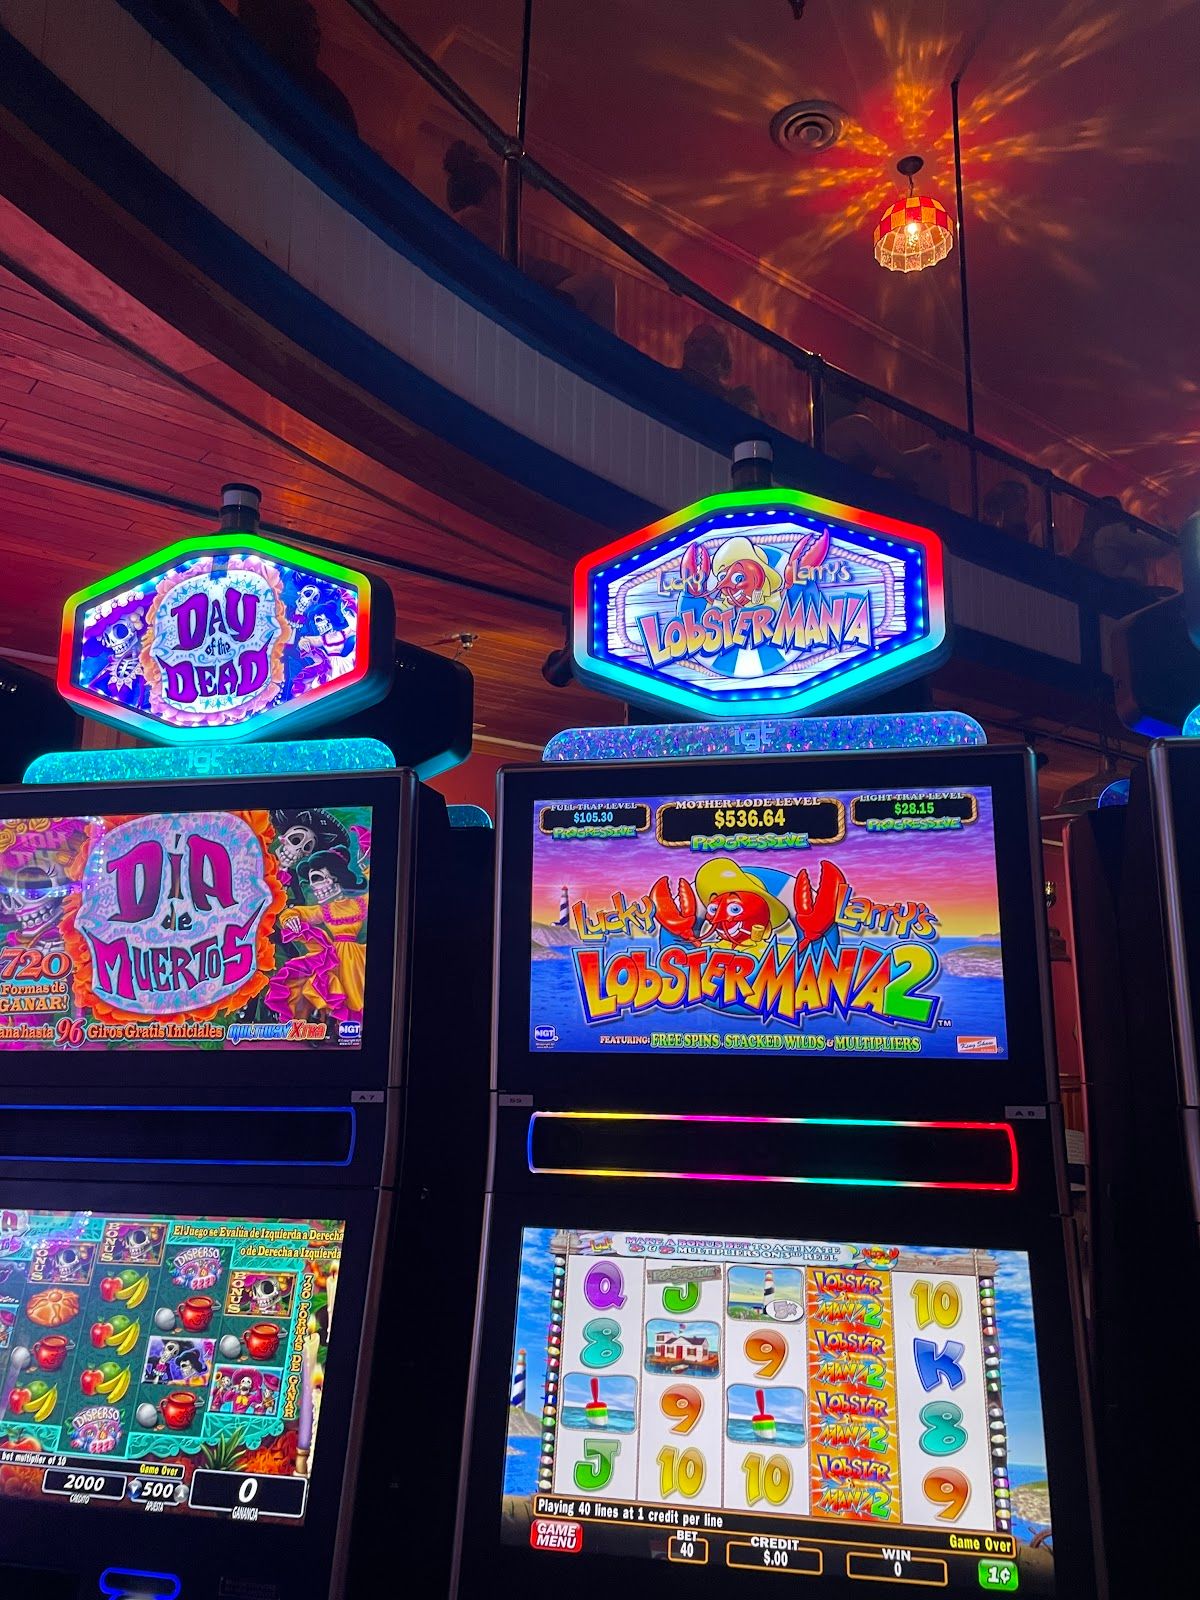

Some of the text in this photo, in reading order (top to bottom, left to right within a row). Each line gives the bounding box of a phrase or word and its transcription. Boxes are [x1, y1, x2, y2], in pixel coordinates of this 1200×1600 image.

[791, 558, 854, 586] Larry's
[656, 569, 706, 598] Lucky
[172, 587, 261, 651] DAY
[205, 637, 231, 656] of the
[163, 644, 271, 703] DEAD
[577, 803, 604, 811] TRAP
[605, 802, 638, 810] LEVEL
[675, 797, 821, 810] MOTHER LODE LEVEL
[860, 792, 965, 802] LIGHT TRAP LEVEL
[573, 811, 614, 823] $105.30
[894, 802, 935, 815] $28.15
[714, 808, 786, 830] $536.64
[866, 817, 962, 831] PROGRESSIVE
[552, 826, 637, 840] PROGRESSIVE
[690, 833, 810, 851] PROGRESSIVE
[160, 901, 193, 932] de
[572, 891, 656, 942] Lucky
[834, 882, 939, 940] Larry's
[1, 948, 72, 979] 720
[82, 912, 261, 1000] MUERTOS
[2, 981, 66, 995] Formas de
[20, 1024, 54, 1039] hasta
[57, 1018, 87, 1044] 96
[87, 1024, 123, 1039] Giros
[124, 1024, 165, 1039] Gratis
[166, 1024, 224, 1038] Iniciales
[599, 1035, 650, 1045] FEATURING:
[650, 1032, 684, 1047] FREE
[725, 1034, 782, 1049] STACKED
[782, 1035, 825, 1050] WILDS
[834, 1036, 921, 1051] MULTIPLIERS
[101, 1222, 120, 1263] BONUS
[173, 1225, 184, 1236] El
[184, 1226, 209, 1238] Juego
[209, 1229, 218, 1237] se
[220, 1226, 249, 1238] Evalúa
[250, 1227, 260, 1238] de
[261, 1228, 301, 1241] Izquierda
[309, 1229, 344, 1241] Derecha
[247, 1246, 257, 1257] de
[258, 1246, 293, 1257] Derecha
[300, 1247, 342, 1260] Izquierda
[625, 1236, 841, 1255] MAKE A BONUS BET TO ACTIVATE
[677, 1246, 760, 1259] MULTIPLIERS
[761, 1250, 781, 1259] ON
[177, 1246, 220, 1266] DISPERSO
[227, 1271, 247, 1314] BONUS
[584, 1260, 628, 1311] Q
[813, 1270, 883, 1295] LOBSTER
[910, 1279, 962, 1330] 10
[579, 1317, 625, 1369] 8
[814, 1330, 886, 1355] LOBSTER
[743, 1328, 789, 1380] 9
[913, 1337, 966, 1393] K
[659, 1383, 705, 1436] 9
[816, 1390, 889, 1417] LOBSTER
[76, 1407, 120, 1427] DISPERSO
[919, 1400, 969, 1457] 8
[2, 1451, 14, 1461] bet
[573, 1437, 622, 1492] J
[140, 1463, 179, 1476] Game Over
[656, 1444, 707, 1499] 10
[817, 1454, 891, 1482] LOBSTER
[63, 1474, 105, 1491] 2000
[741, 1451, 794, 1507] 10
[141, 1482, 174, 1498] 500
[238, 1478, 258, 1503] 0
[921, 1466, 972, 1523] 9
[538, 1499, 723, 1528] Playing 40 lines at 1 credit per line
[537, 1522, 577, 1537] GAME
[676, 1530, 698, 1542] BET
[536, 1535, 577, 1549] MENU
[680, 1543, 694, 1557] 40
[750, 1536, 800, 1551] CREDIT
[949, 1533, 1012, 1553] Game Over
[763, 1550, 788, 1567] $.00
[882, 1548, 911, 1562] WIN
[894, 1562, 902, 1577] 0
[986, 1566, 1012, 1584] 1¢
